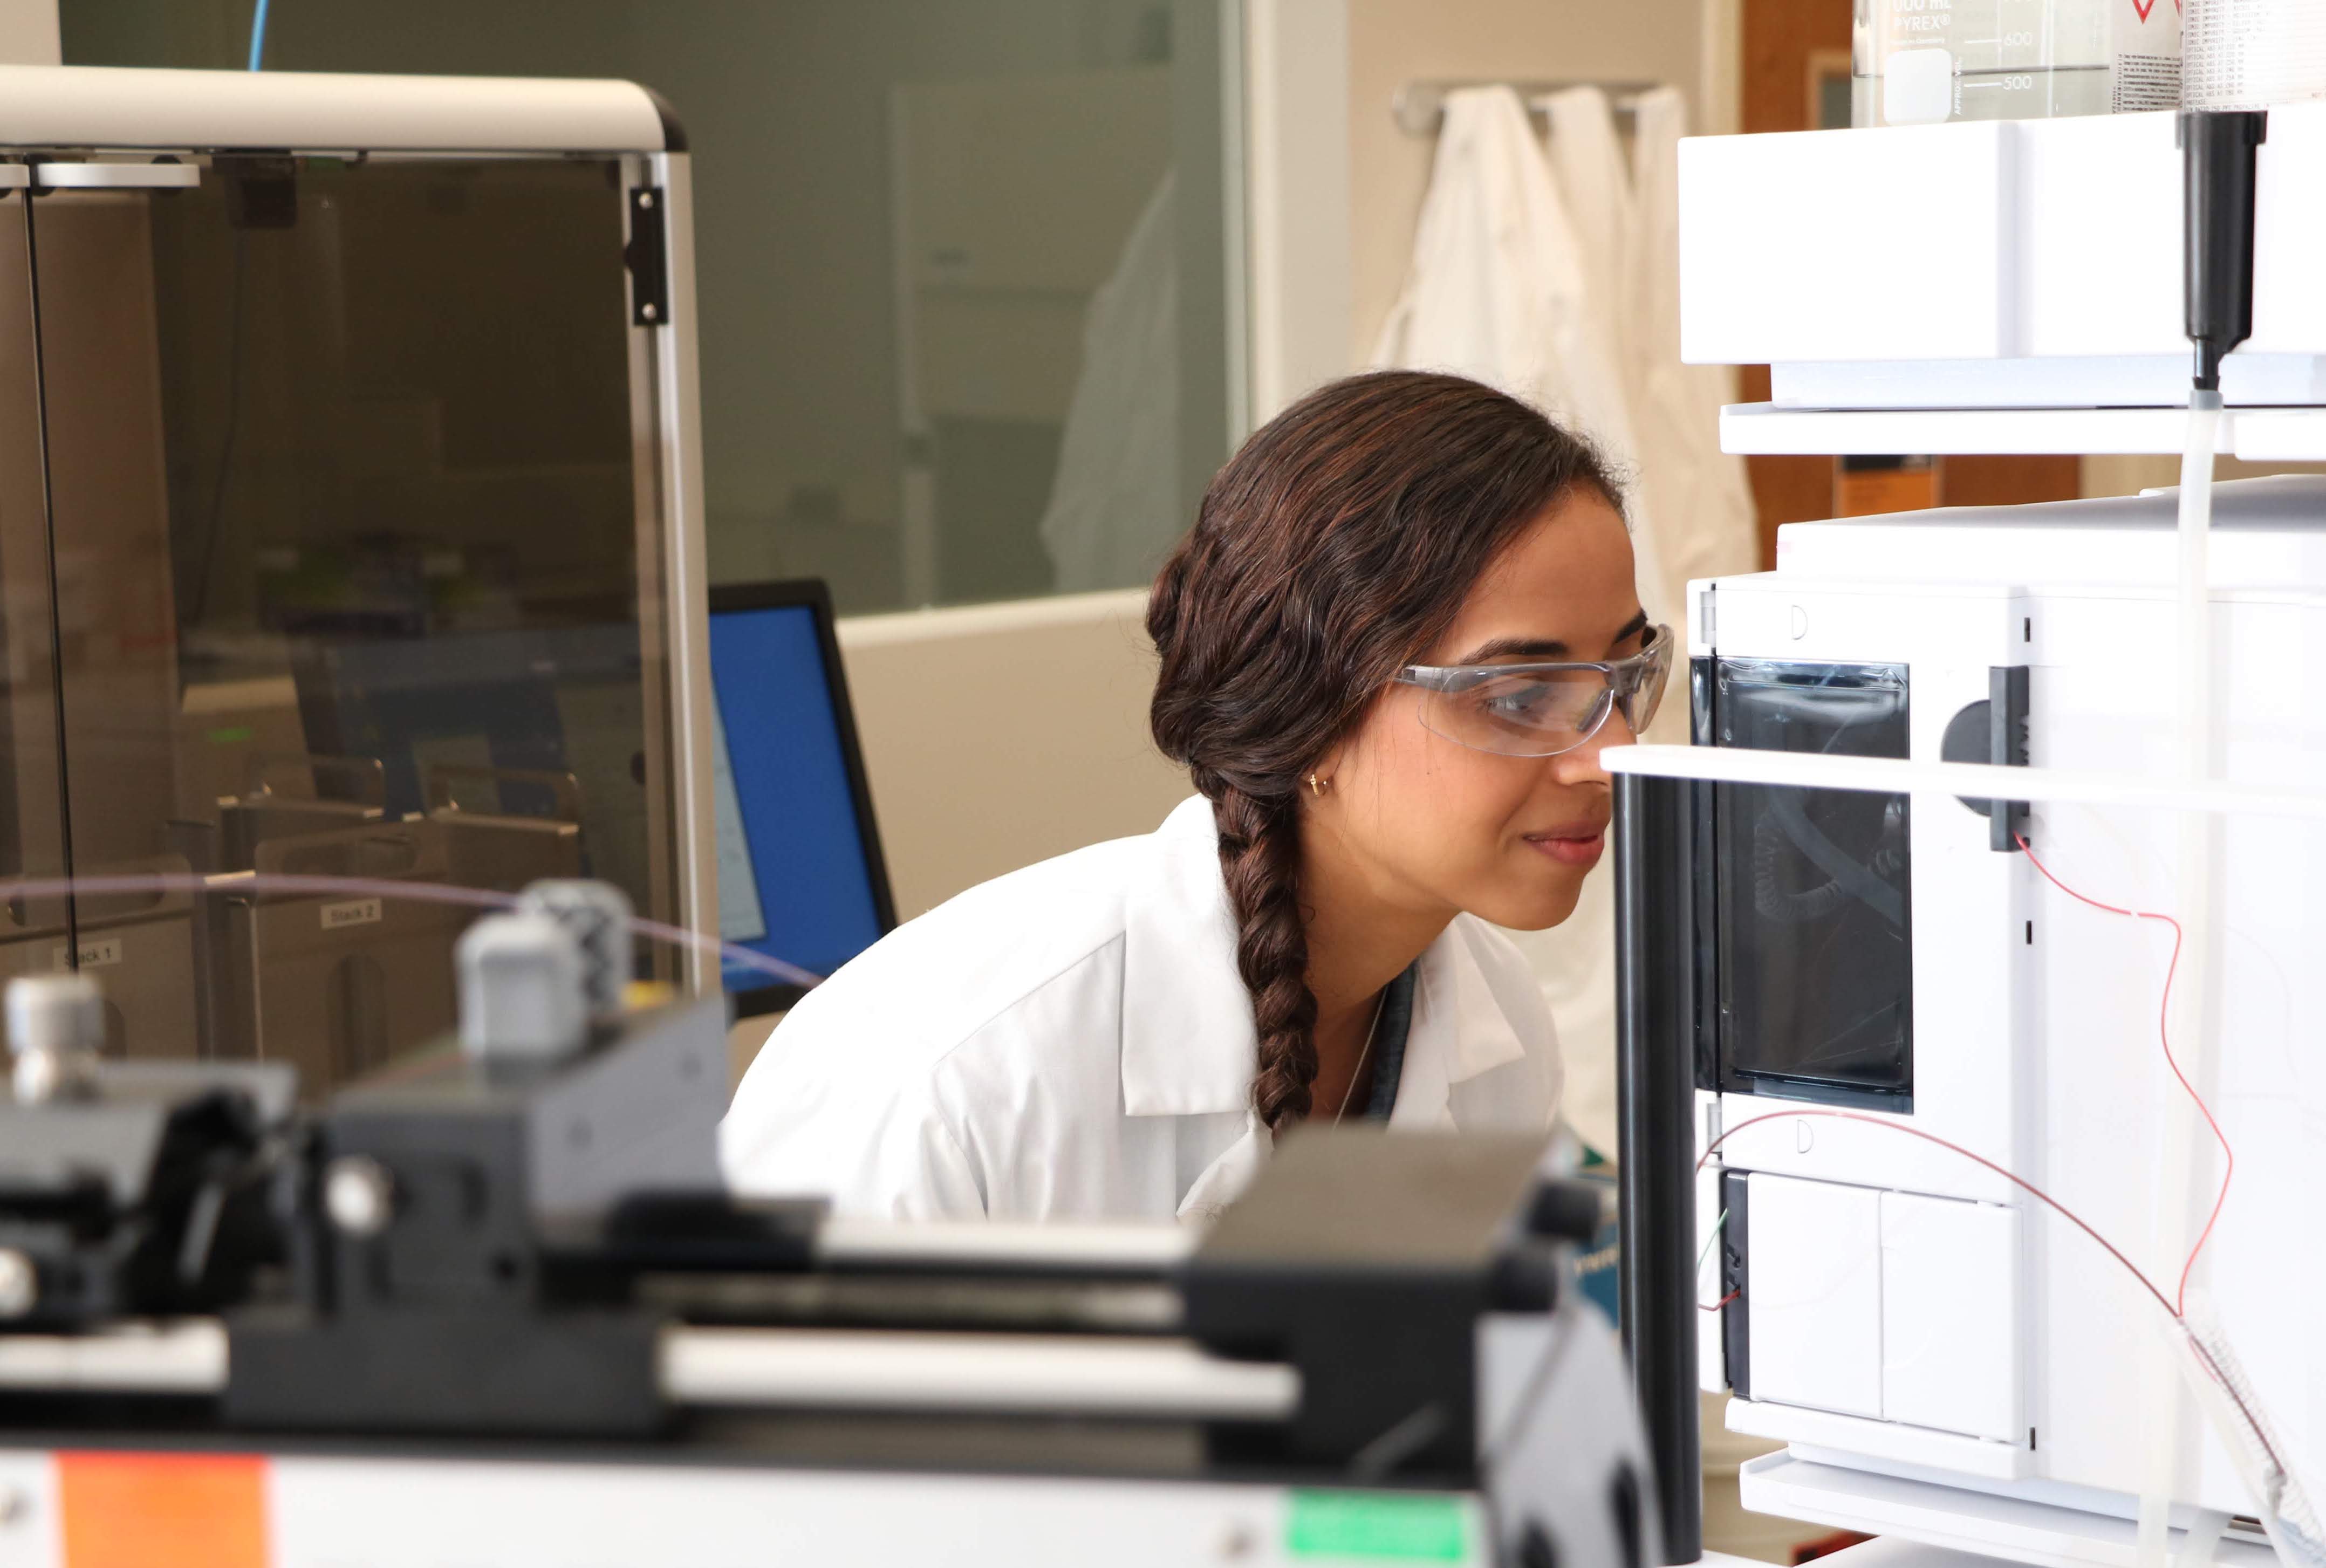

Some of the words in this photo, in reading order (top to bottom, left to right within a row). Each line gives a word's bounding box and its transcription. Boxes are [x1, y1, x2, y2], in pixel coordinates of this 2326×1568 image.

[2002, 31, 2033, 46] 600
[2002, 76, 2032, 90] 500
[331, 907, 363, 923] Stack
[366, 903, 377, 919] 2
[64, 948, 100, 966] Sack
